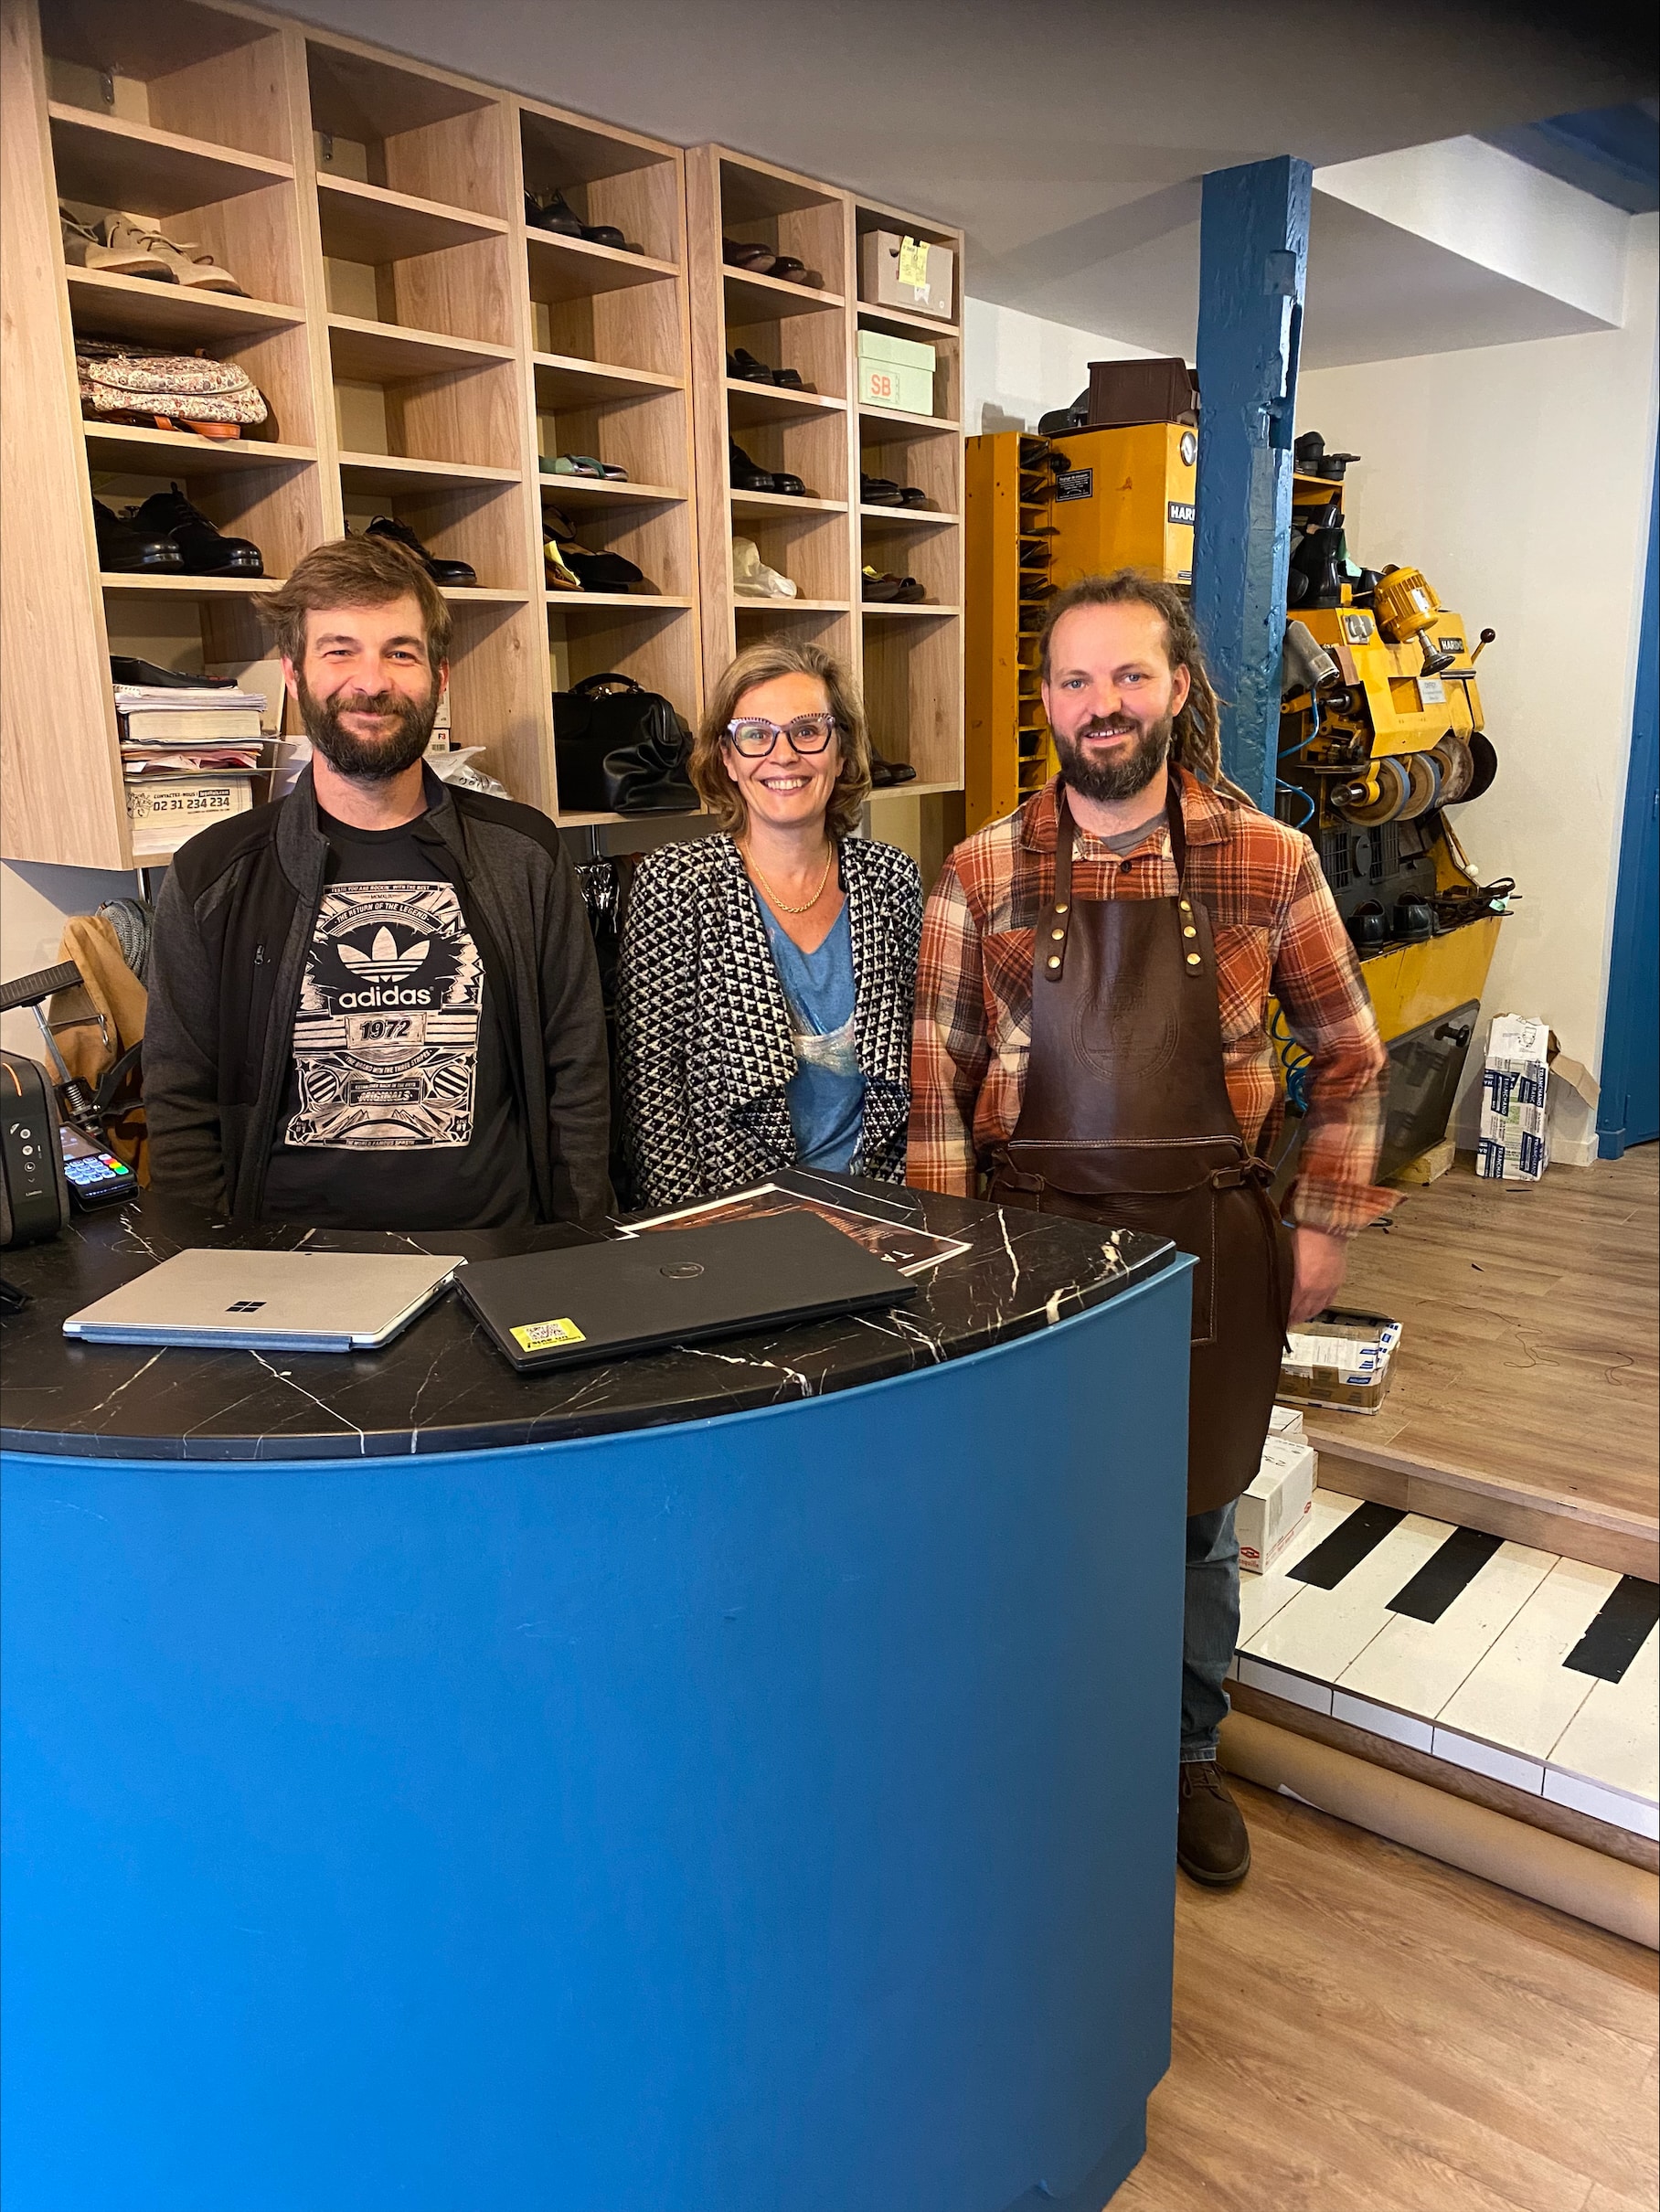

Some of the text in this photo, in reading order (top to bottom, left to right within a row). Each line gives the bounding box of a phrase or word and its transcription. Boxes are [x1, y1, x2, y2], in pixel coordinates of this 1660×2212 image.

[871, 374, 891, 397] SB
[153, 797, 230, 811] 02 31 234 234
[336, 912, 348, 923] THE
[348, 903, 374, 918] RETURN
[385, 902, 399, 910] THE
[399, 905, 429, 920] LEGEND
[338, 985, 431, 1008] adidas
[359, 1018, 412, 1041] 1972
